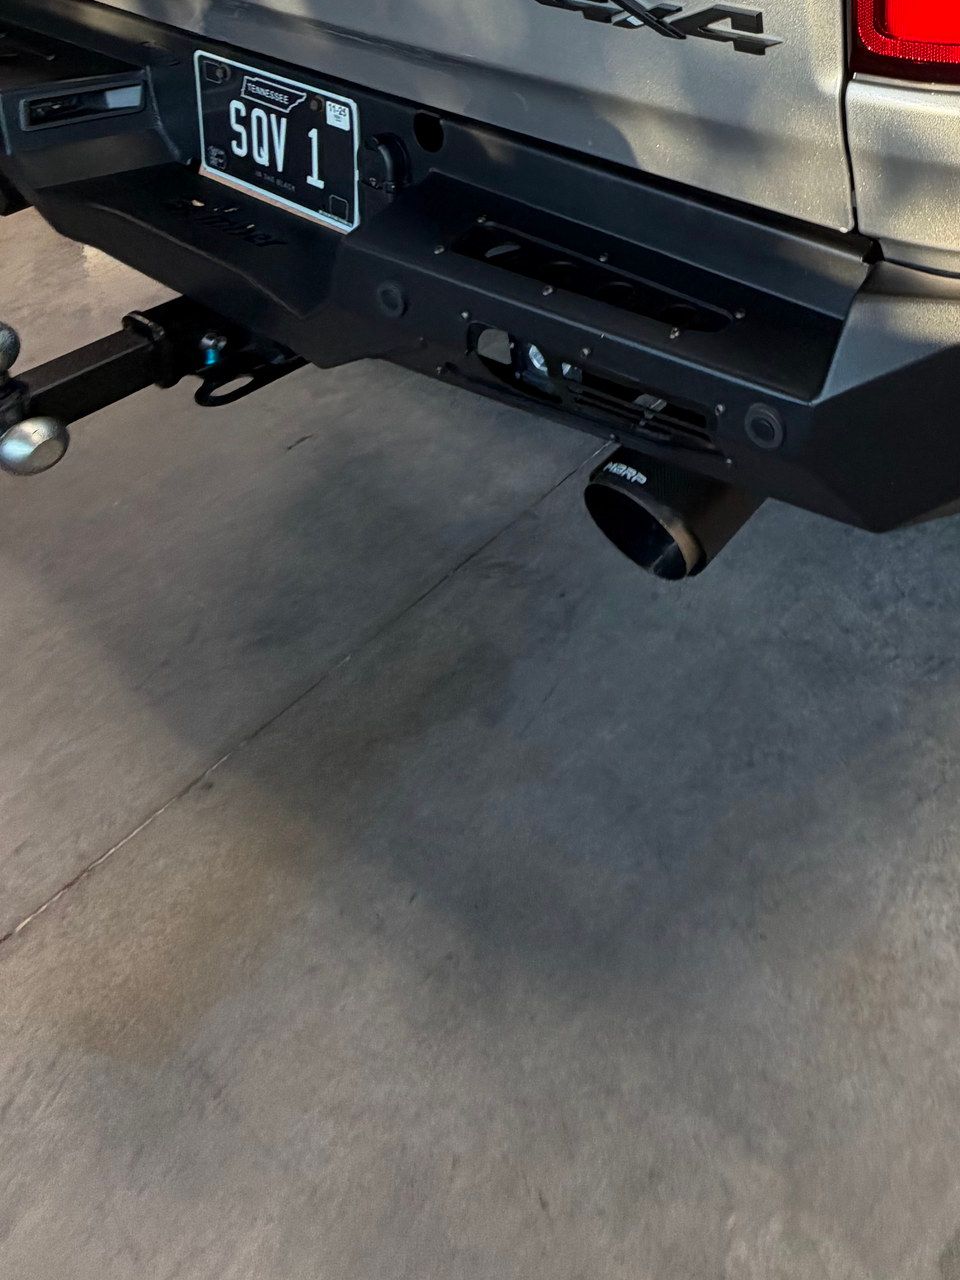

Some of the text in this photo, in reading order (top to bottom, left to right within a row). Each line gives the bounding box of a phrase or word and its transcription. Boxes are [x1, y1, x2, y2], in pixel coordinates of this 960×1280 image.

[246, 83, 290, 105] TENNESSEE
[229, 99, 325, 190] SQV 1
